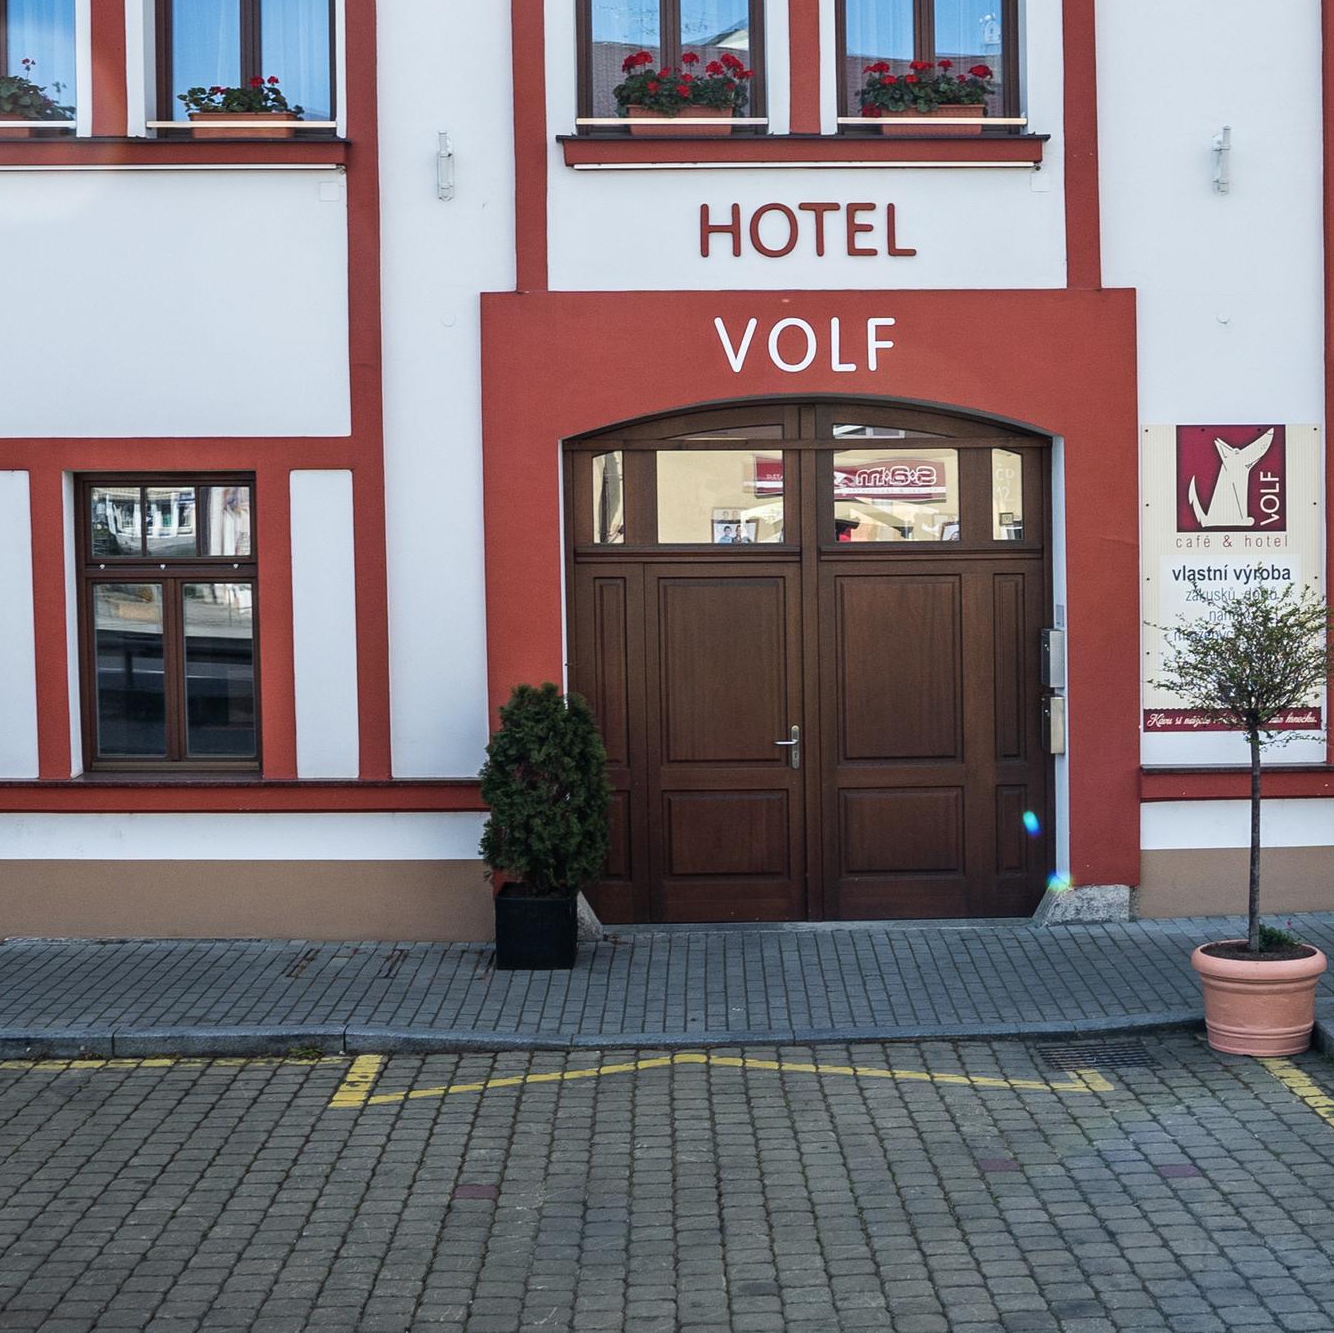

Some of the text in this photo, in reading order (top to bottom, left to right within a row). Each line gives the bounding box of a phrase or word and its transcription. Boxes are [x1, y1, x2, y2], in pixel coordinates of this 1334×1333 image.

[700, 202, 917, 258] HOTEL
[714, 316, 896, 373] VOLF
[1259, 471, 1280, 526] VOLF
[1175, 534, 1289, 549] café & hotel
[1172, 563, 1292, 585] vlastní výroba
